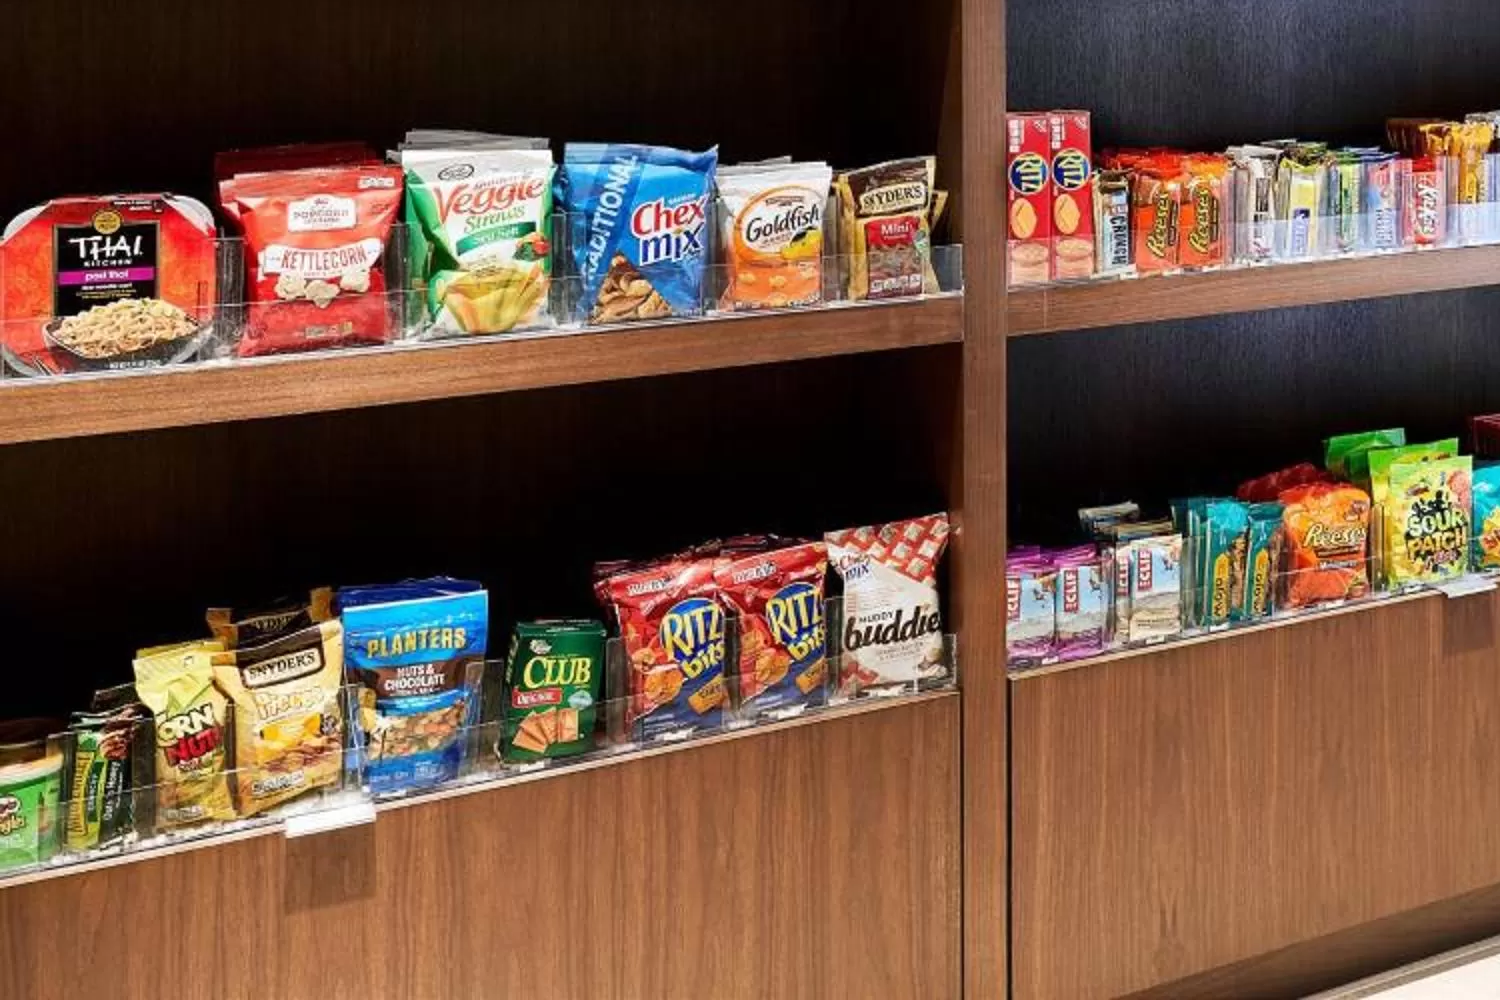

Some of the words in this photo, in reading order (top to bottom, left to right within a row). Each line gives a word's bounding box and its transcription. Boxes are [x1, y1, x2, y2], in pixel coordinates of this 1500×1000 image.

[1015, 155, 1042, 192] RITZ
[1058, 152, 1084, 188] RITZ
[433, 178, 546, 225] Veggie
[862, 186, 923, 207] SNYDER'S
[633, 197, 706, 238] Chex
[746, 203, 820, 243] Goldfish
[881, 221, 910, 236] Mini
[68, 234, 144, 261] THAI
[641, 222, 705, 264] mix
[1110, 215, 1129, 265] CRUNCH
[83, 258, 132, 268] KITCHEN
[281, 245, 368, 271] KETTLECORN
[1408, 508, 1464, 537] SOUR
[1407, 527, 1467, 561] PATCH
[767, 588, 824, 647] RITZ
[844, 606, 941, 651] buddie
[859, 611, 894, 624] MUDDY
[367, 627, 467, 658] PLANTERS
[661, 605, 722, 666] RITZ
[248, 651, 316, 676] SNYDER'S
[397, 665, 425, 678] NUTS
[426, 664, 434, 674] &
[524, 656, 592, 689] CLUB
[682, 641, 725, 678] bits
[384, 673, 445, 691] CHOCOLATE
[105, 760, 121, 789] Honey
